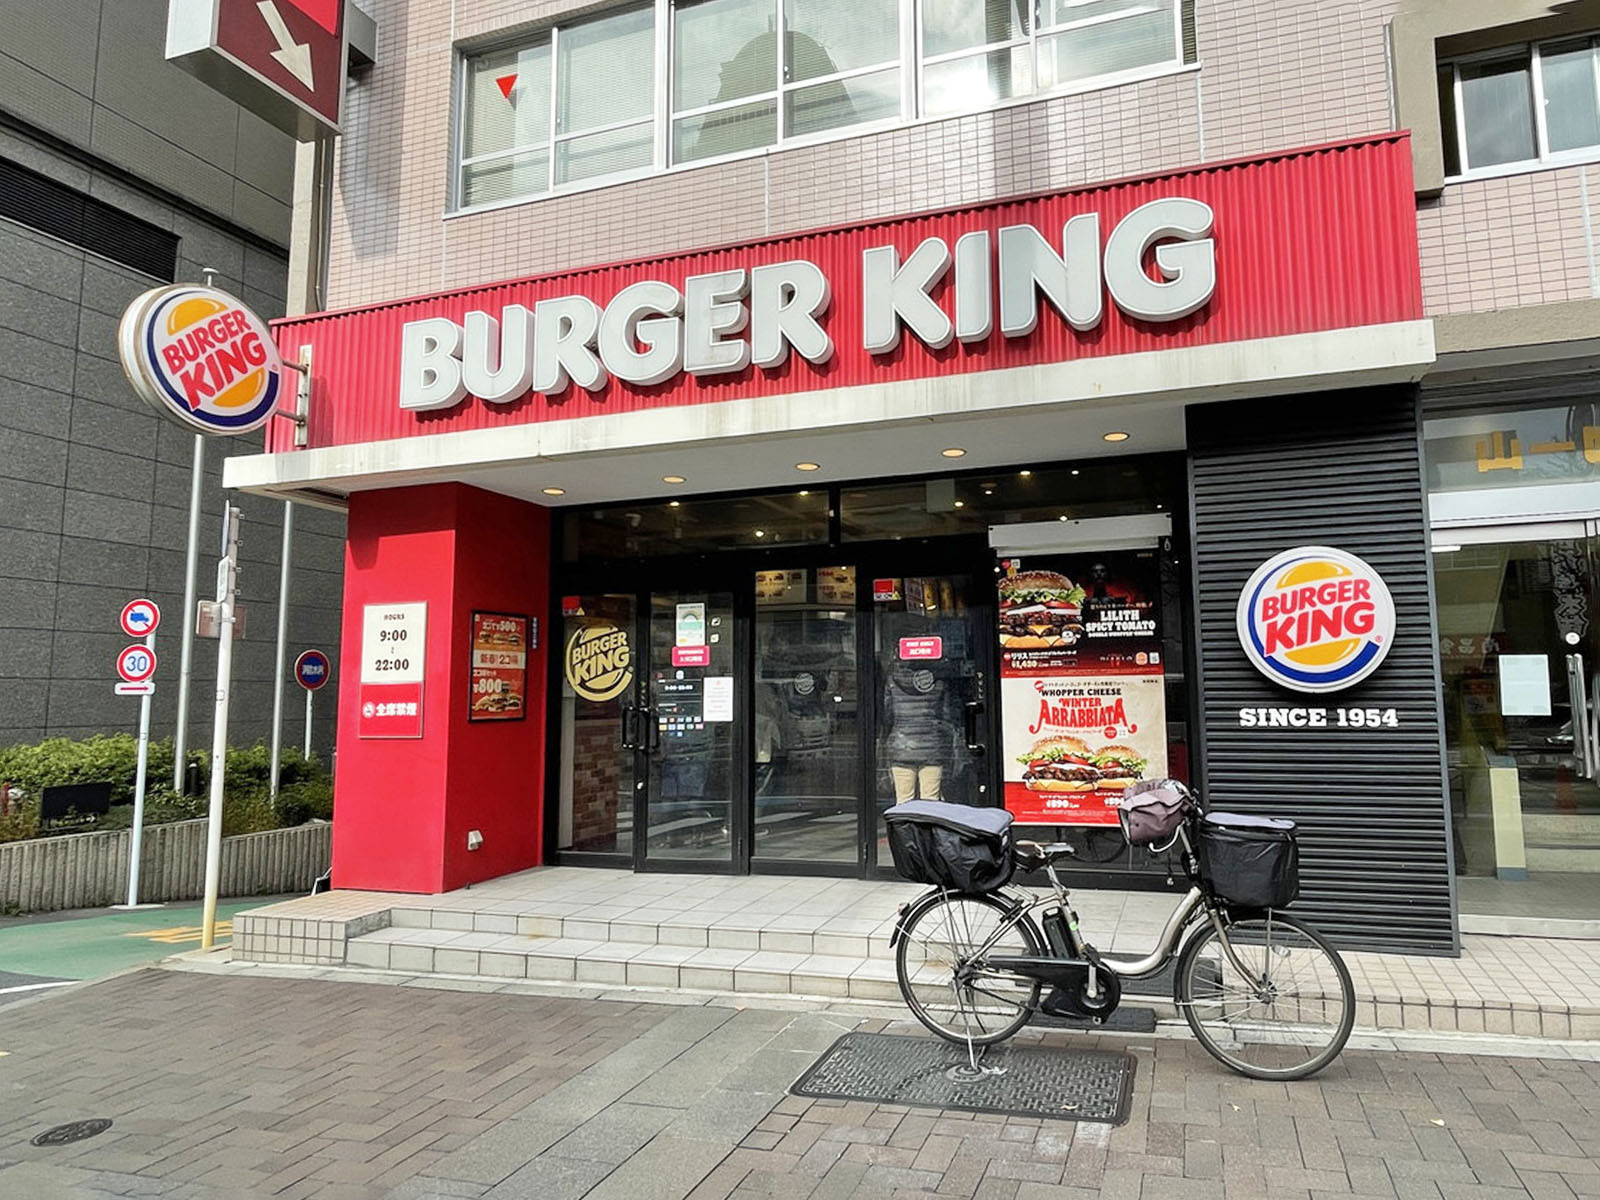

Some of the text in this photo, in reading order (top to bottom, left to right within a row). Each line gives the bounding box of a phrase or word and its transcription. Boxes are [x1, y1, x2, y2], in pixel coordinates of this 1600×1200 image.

[399, 197, 1217, 413] BURGER KING
[162, 309, 252, 376] BURGER
[179, 331, 268, 410] KING
[1261, 578, 1371, 622] BURGER
[1085, 620, 1156, 632] SPICY TOMATO
[1100, 609, 1140, 621] LILITH
[1265, 601, 1375, 655] KING
[380, 629, 407, 642] 9:00
[572, 631, 627, 665] BURGER
[126, 656, 147, 672] 30
[375, 658, 409, 671] 22:00
[575, 646, 630, 683] KING
[1041, 688, 1122, 696] WHOPPER CHEESE
[1059, 697, 1102, 708] WINTER
[1029, 698, 1138, 734] ARRABBIATA
[1239, 708, 1398, 727] SINCE 1954
